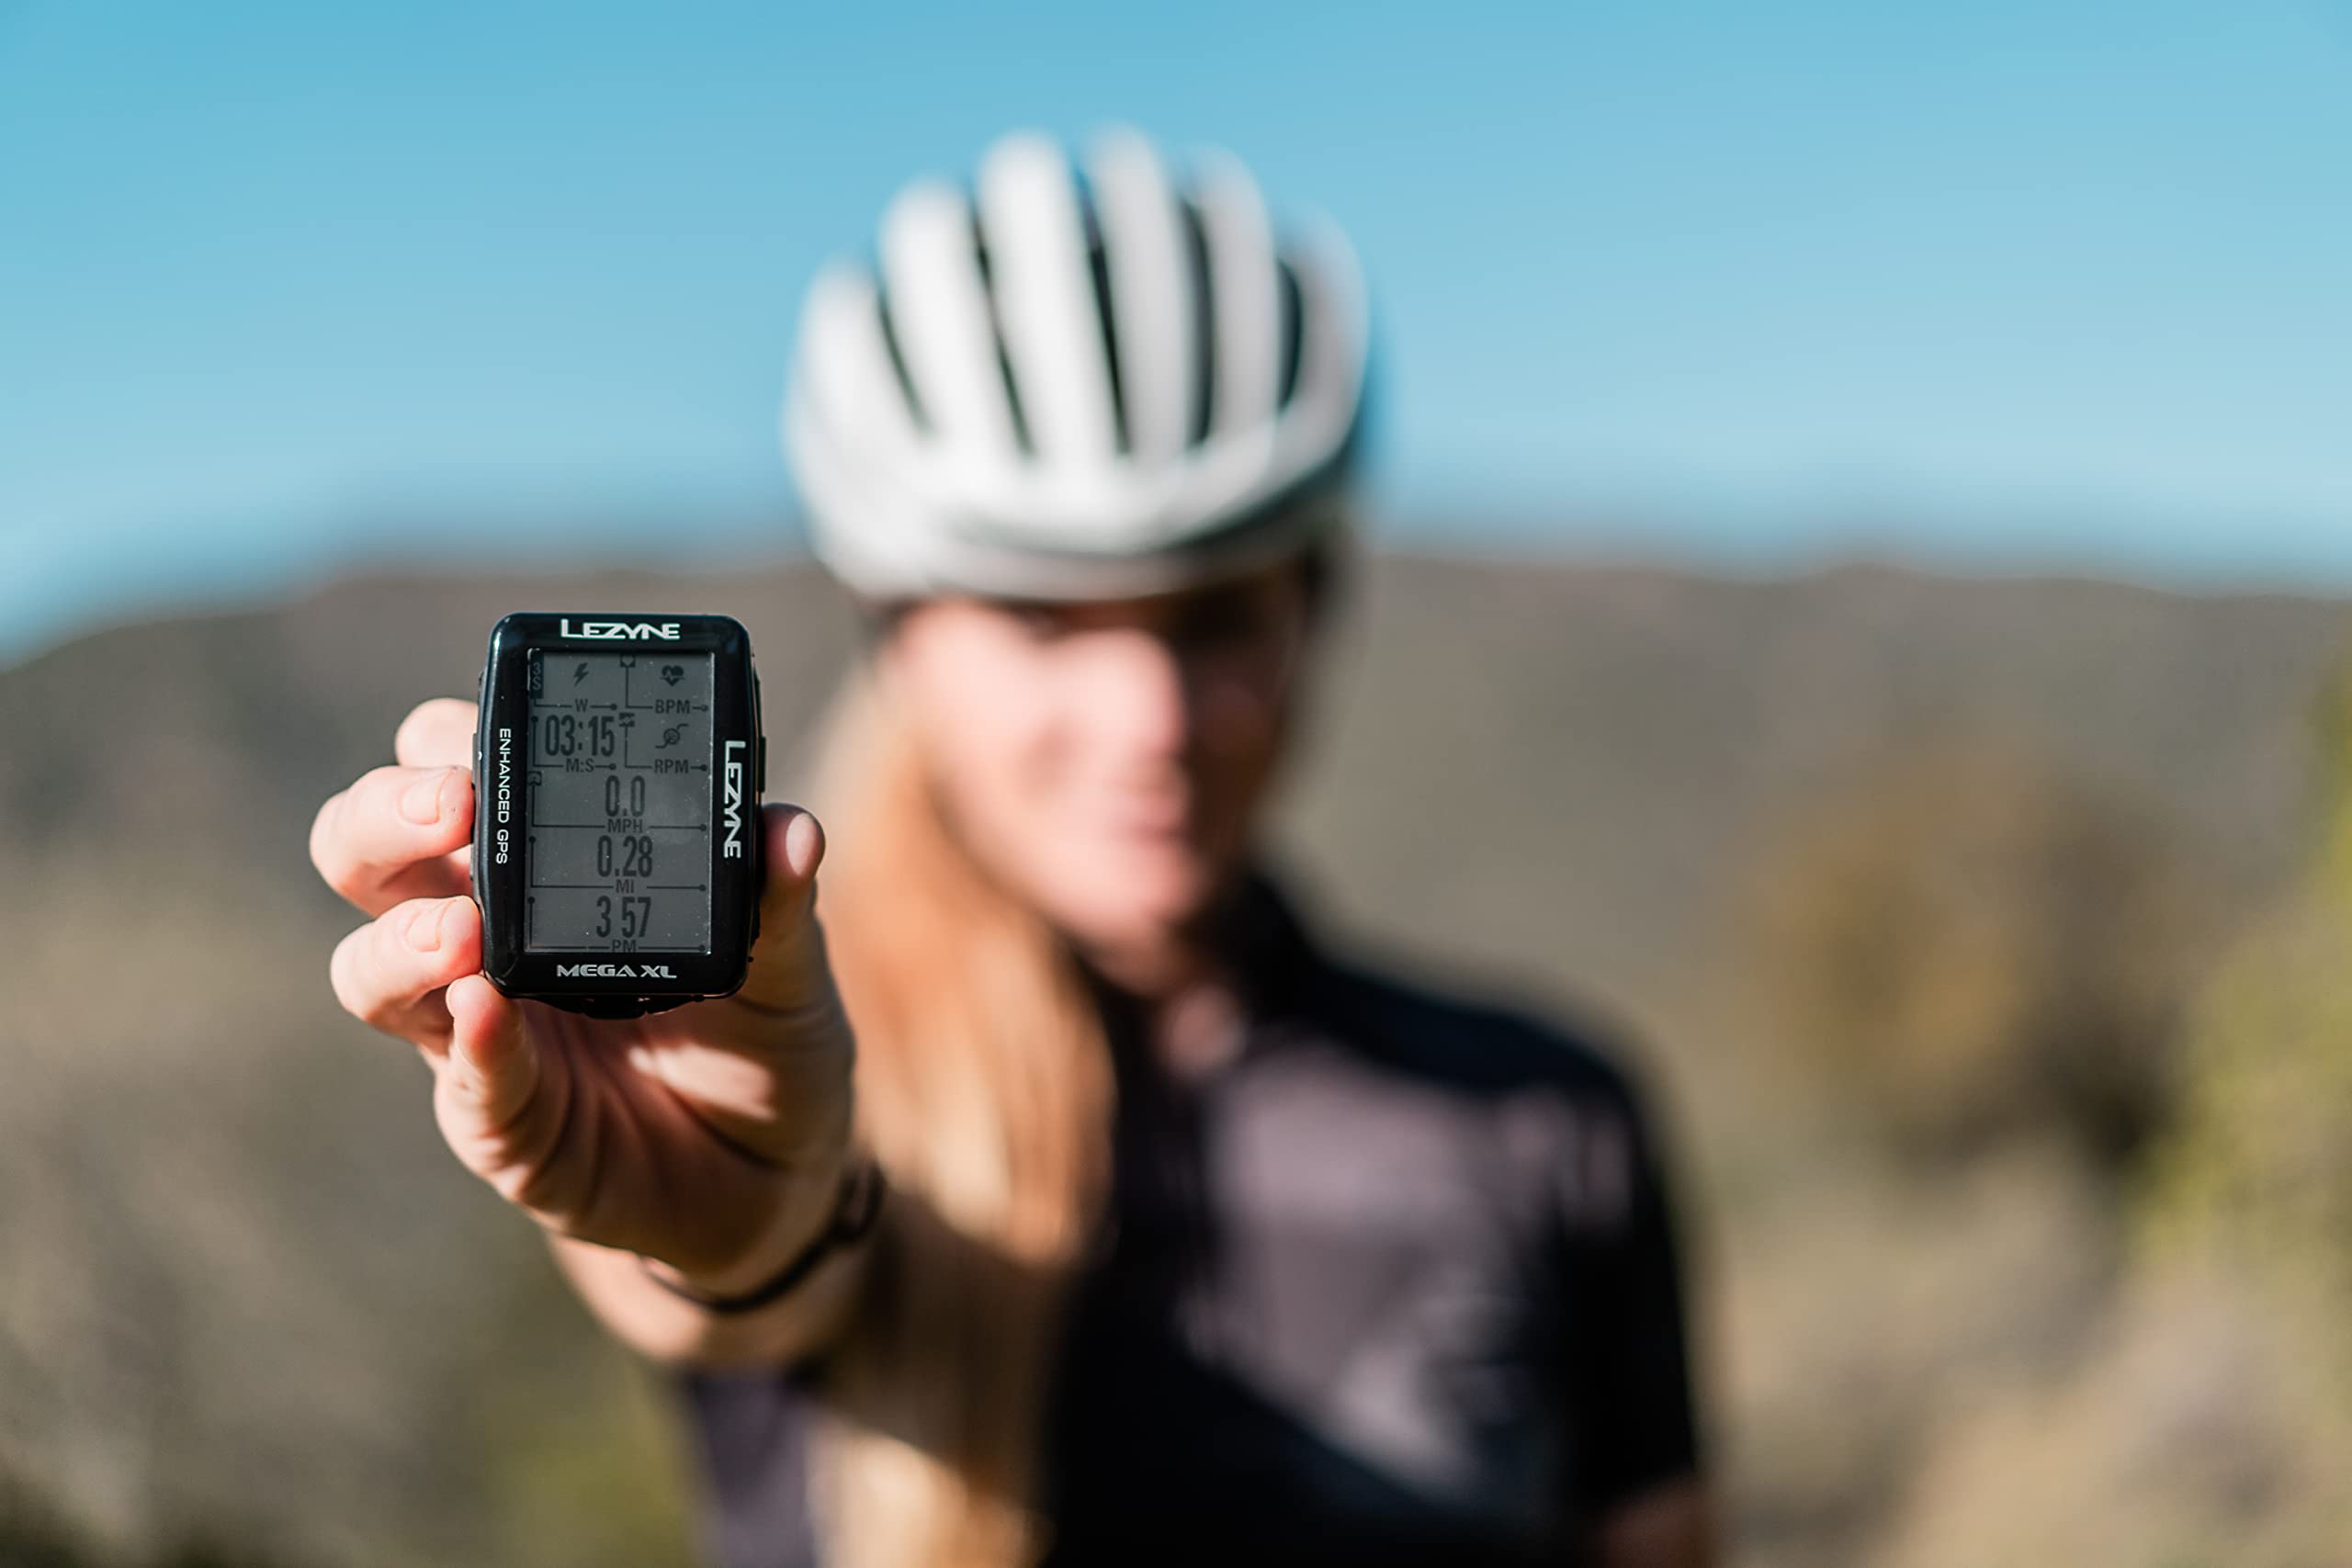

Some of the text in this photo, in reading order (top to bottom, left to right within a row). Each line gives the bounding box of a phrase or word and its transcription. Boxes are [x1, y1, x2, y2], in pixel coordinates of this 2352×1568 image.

[560, 618, 681, 639] LEZYNE
[574, 698, 589, 713] W
[655, 699, 691, 715] BPM
[545, 714, 616, 757] 03:15
[566, 758, 594, 773] M:S
[654, 759, 689, 774] RPM
[495, 728, 512, 864] ENHANCED GPS
[605, 774, 646, 818] 0.0
[723, 739, 747, 859] LEZYNE
[606, 818, 643, 834] MPH
[597, 834, 653, 878] 0.28
[616, 878, 635, 894] MI
[611, 939, 637, 953] PM
[556, 964, 678, 979] MEGA XL
